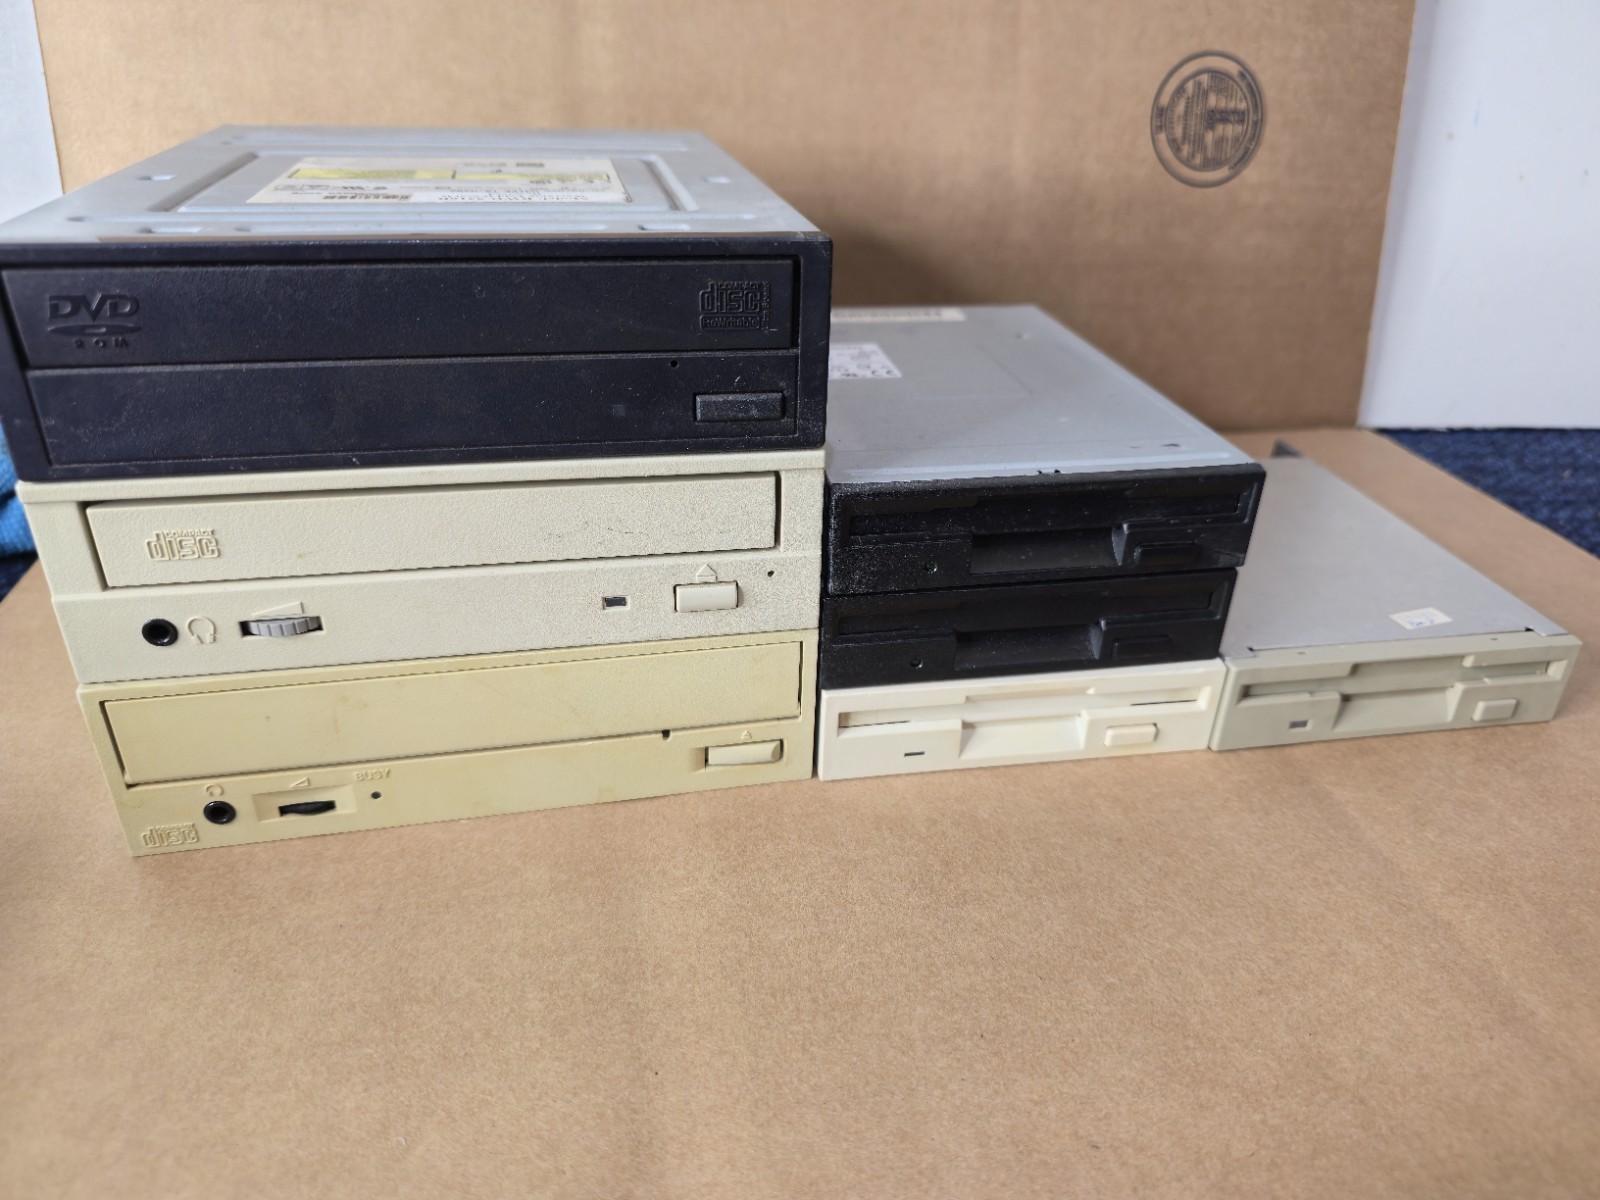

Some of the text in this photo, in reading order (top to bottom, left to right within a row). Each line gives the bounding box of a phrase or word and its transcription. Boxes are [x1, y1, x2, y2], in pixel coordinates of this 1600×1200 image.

[48, 294, 140, 323] DVD
[699, 280, 760, 313] disc
[145, 531, 221, 561] disc
[164, 528, 216, 539] COMPACT
[353, 768, 392, 782] BUSY
[141, 826, 200, 848] disc
